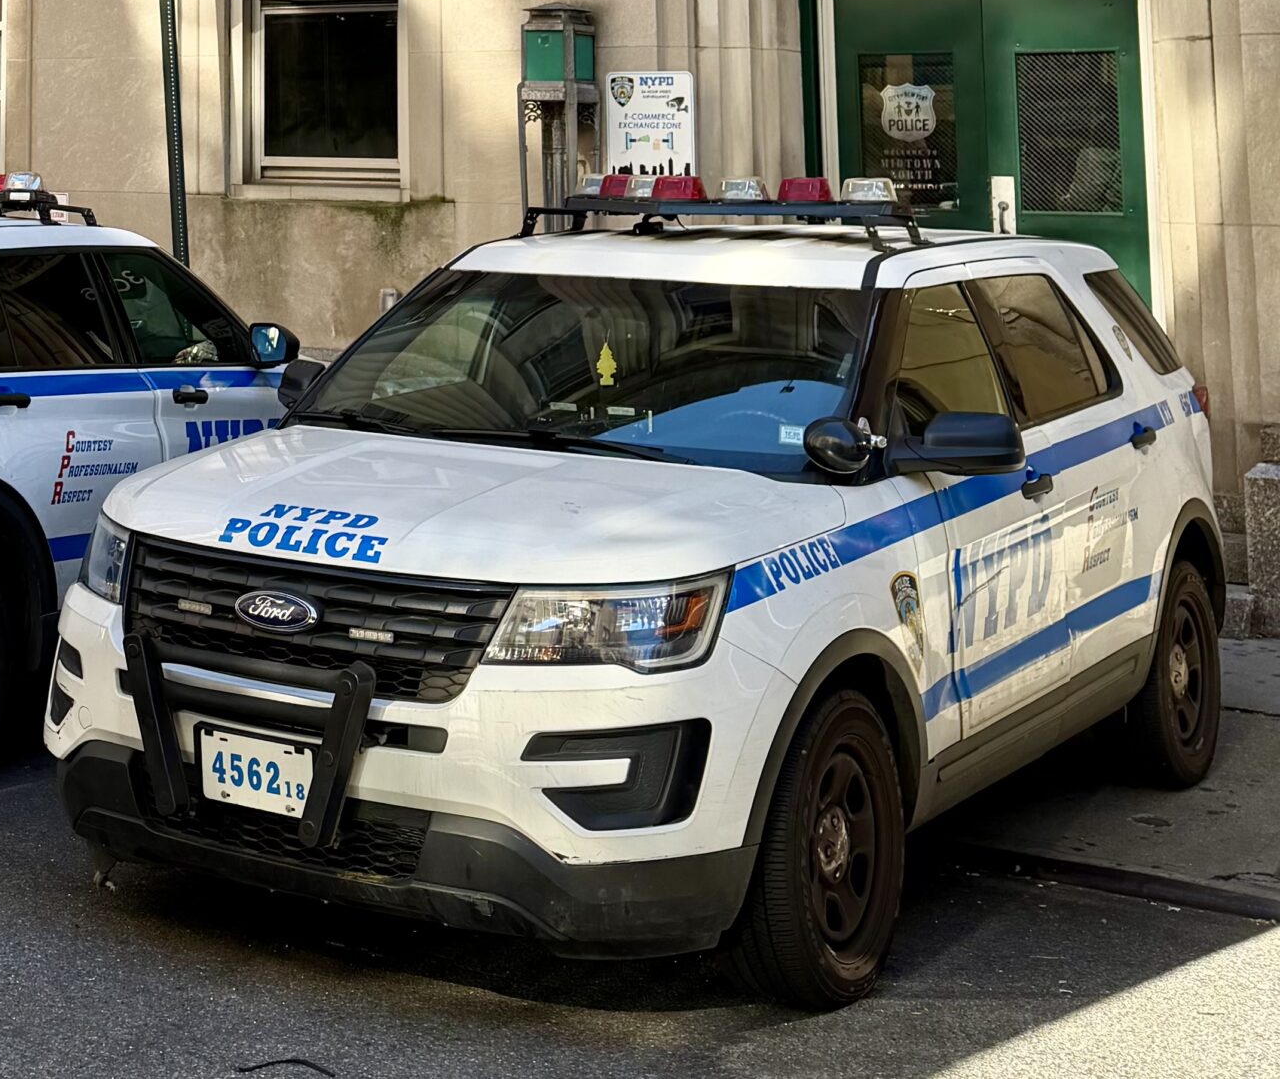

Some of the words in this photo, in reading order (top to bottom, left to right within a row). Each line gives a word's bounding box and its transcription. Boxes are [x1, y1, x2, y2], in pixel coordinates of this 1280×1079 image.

[639, 76, 674, 86] NYPD
[624, 113, 675, 121] E-COMMERCE
[888, 119, 929, 132] POLICE
[66, 431, 113, 453] COURTESY
[58, 455, 138, 478] PROFESSIONALISM
[51, 482, 93, 505] RESPECT
[259, 504, 379, 528] NYPD
[218, 518, 388, 564] POLICE
[765, 536, 841, 591] POLICE
[947, 514, 1053, 656] NYPD
[249, 595, 295, 622] Ford
[212, 751, 281, 796] 4562
[284, 781, 305, 800] 18
